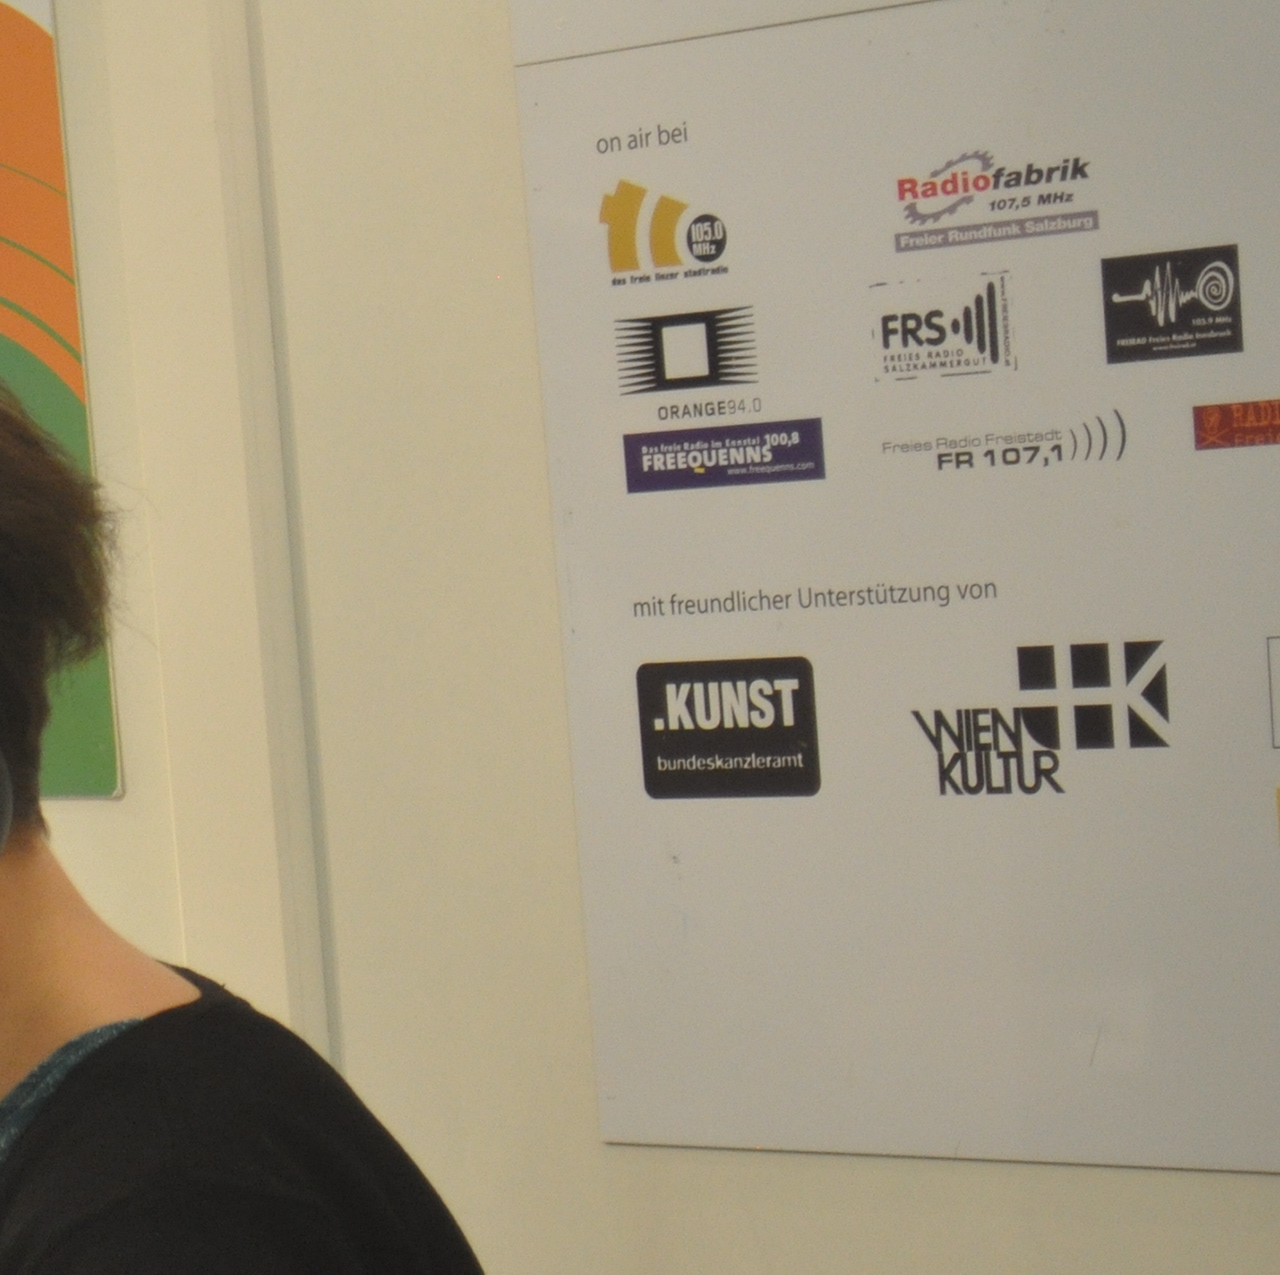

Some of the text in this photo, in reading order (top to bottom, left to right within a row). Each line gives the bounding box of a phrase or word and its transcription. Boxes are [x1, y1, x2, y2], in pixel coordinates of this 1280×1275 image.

[596, 122, 688, 154] on air bei
[897, 157, 1090, 201] Radiofabrik
[989, 191, 1074, 211] 107,5 MHz
[691, 220, 724, 256] 105.0 MHz
[900, 216, 1094, 248] Freier Rundfunk Salzburg
[881, 310, 946, 349] FRS
[884, 349, 964, 362] FREIES RADIO
[884, 357, 987, 373] SALZKAMMERGUT
[684, 440, 708, 450] Radio
[711, 438, 723, 449] im
[764, 431, 800, 450] 100,8
[882, 429, 1062, 454] Freies Radio Freistadt
[642, 445, 774, 474] FREEQUENNS
[937, 443, 1063, 470] FR 107,1
[632, 582, 998, 618] mit freundlicher Unterstützung von
[910, 706, 1024, 752] WIEN
[656, 752, 805, 772] bundeskanzleramt
[937, 750, 1066, 796] KULTUR
